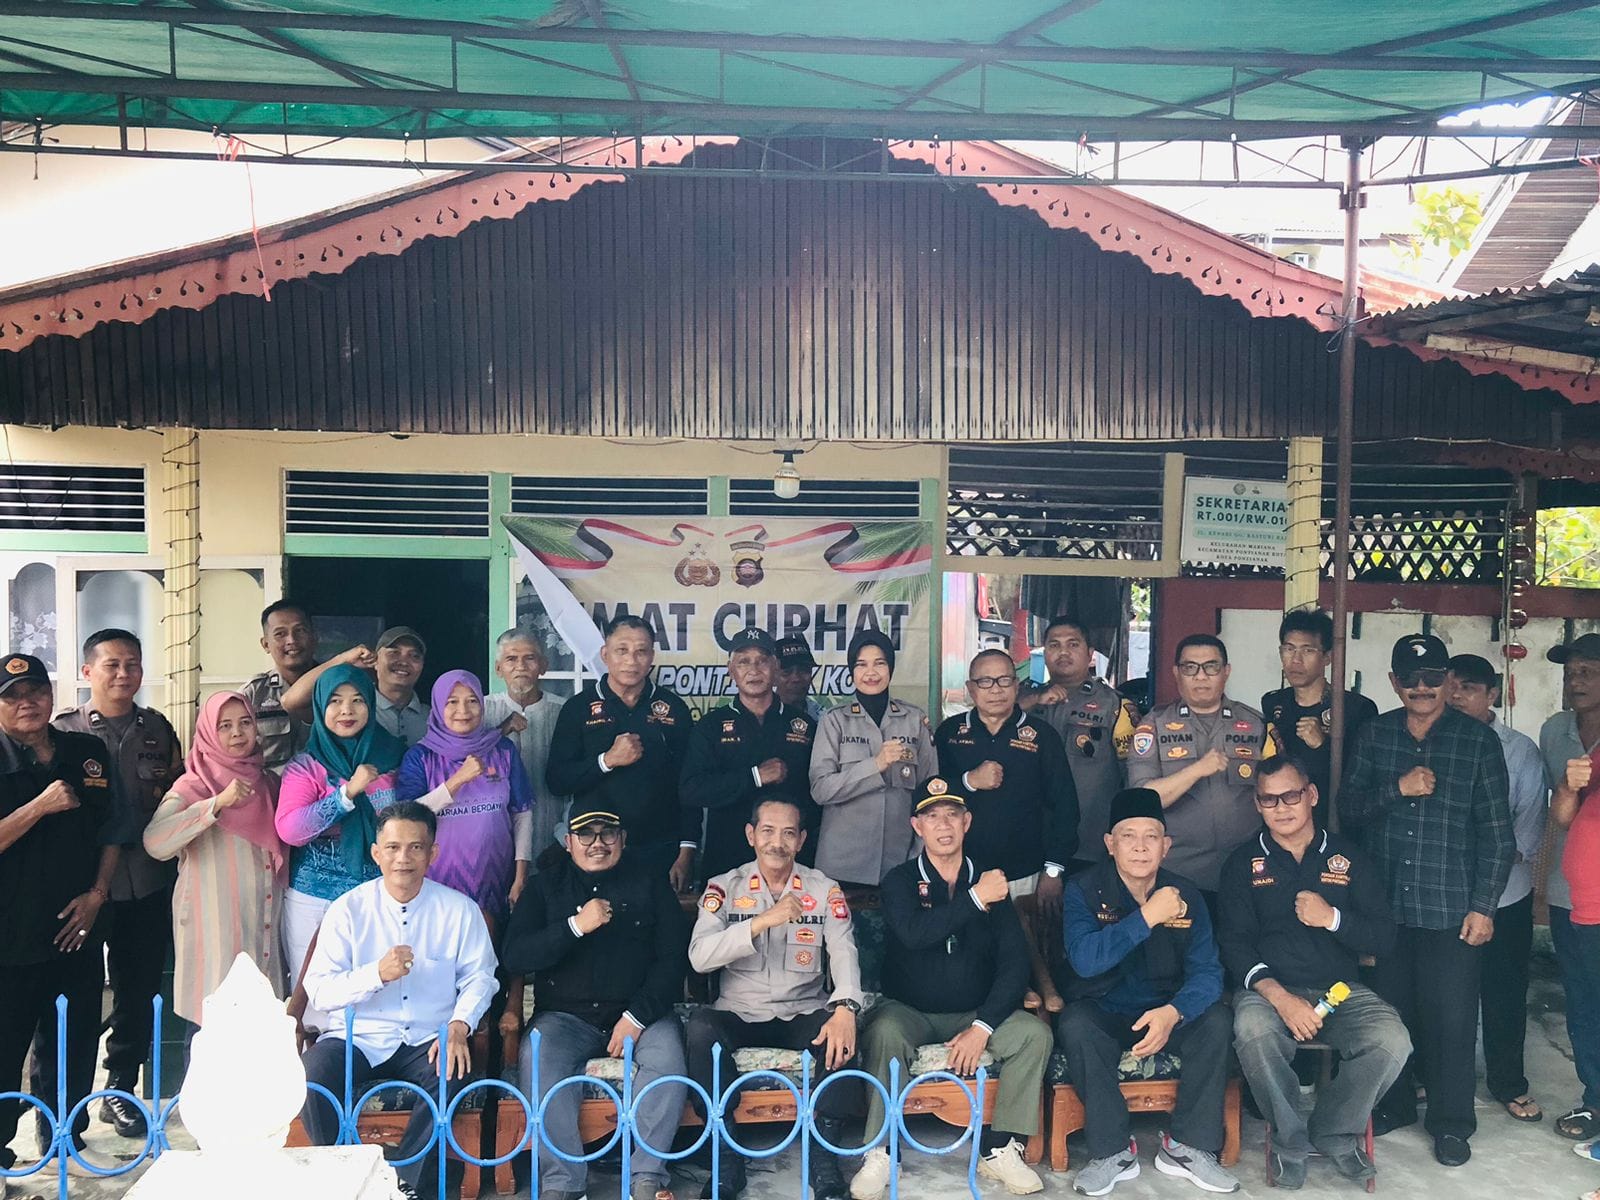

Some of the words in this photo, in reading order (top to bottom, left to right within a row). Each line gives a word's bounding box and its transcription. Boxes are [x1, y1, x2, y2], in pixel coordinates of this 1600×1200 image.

[1196, 497, 1287, 513] SEKRETARIA
[1197, 511, 1287, 525] RT.001/RW.01
[580, 603, 695, 651] MAT
[1070, 710, 1104, 723] POLRI
[1160, 734, 1193, 744] DIYAN
[1225, 734, 1258, 744] POLRI
